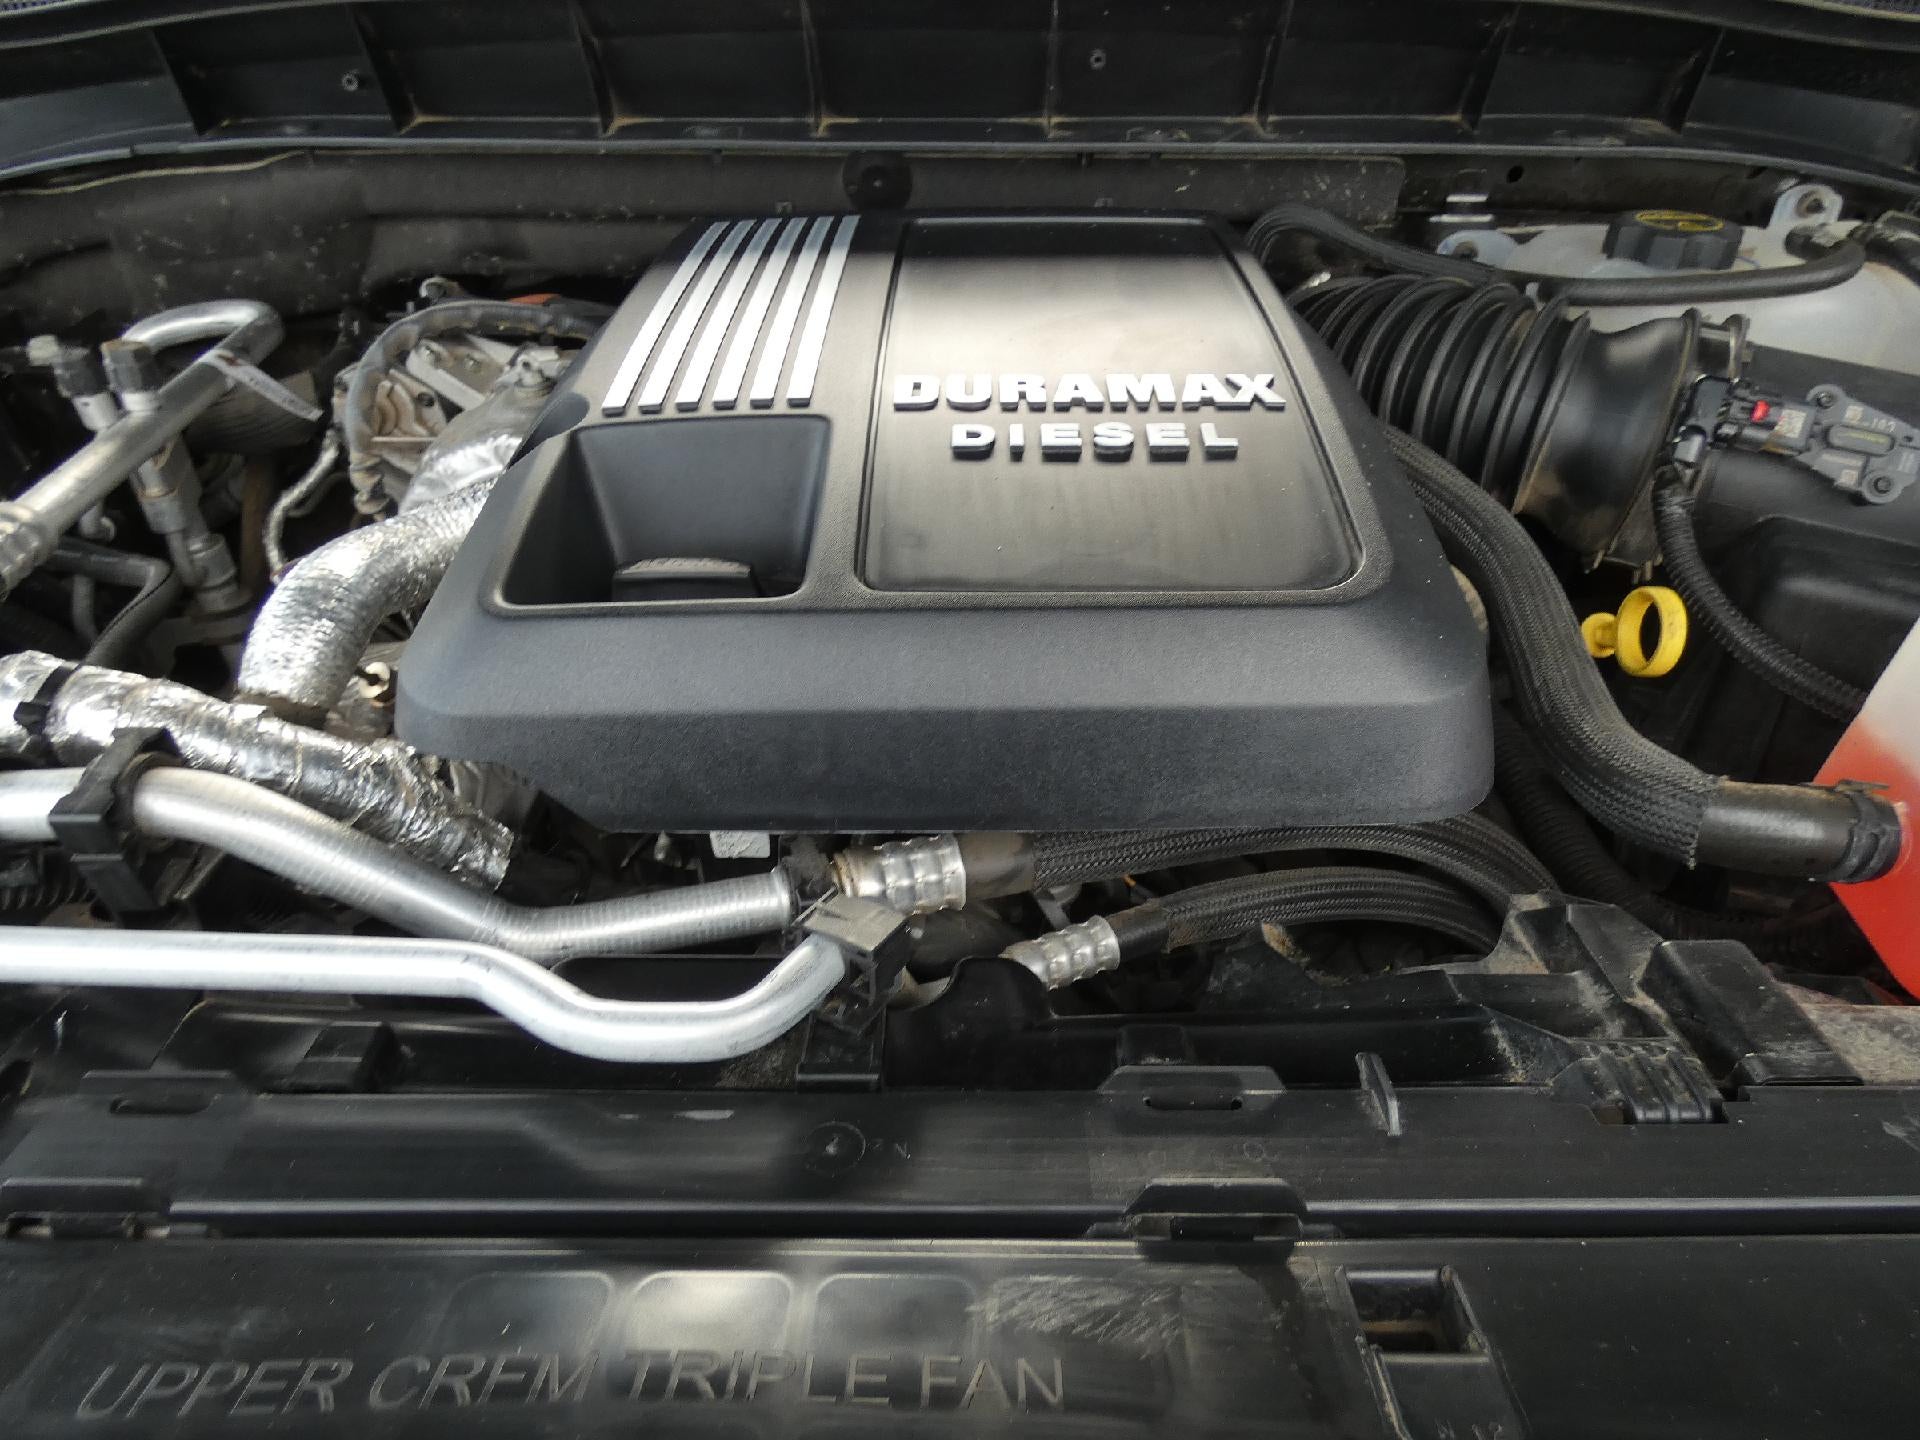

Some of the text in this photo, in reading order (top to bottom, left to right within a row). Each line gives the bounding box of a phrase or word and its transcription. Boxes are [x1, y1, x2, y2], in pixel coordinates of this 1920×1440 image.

[894, 373, 1286, 411] DURAMAX
[952, 422, 1239, 460] DIESEL
[76, 1349, 1064, 1419] UPPER CRFM TRIPLE FAN
